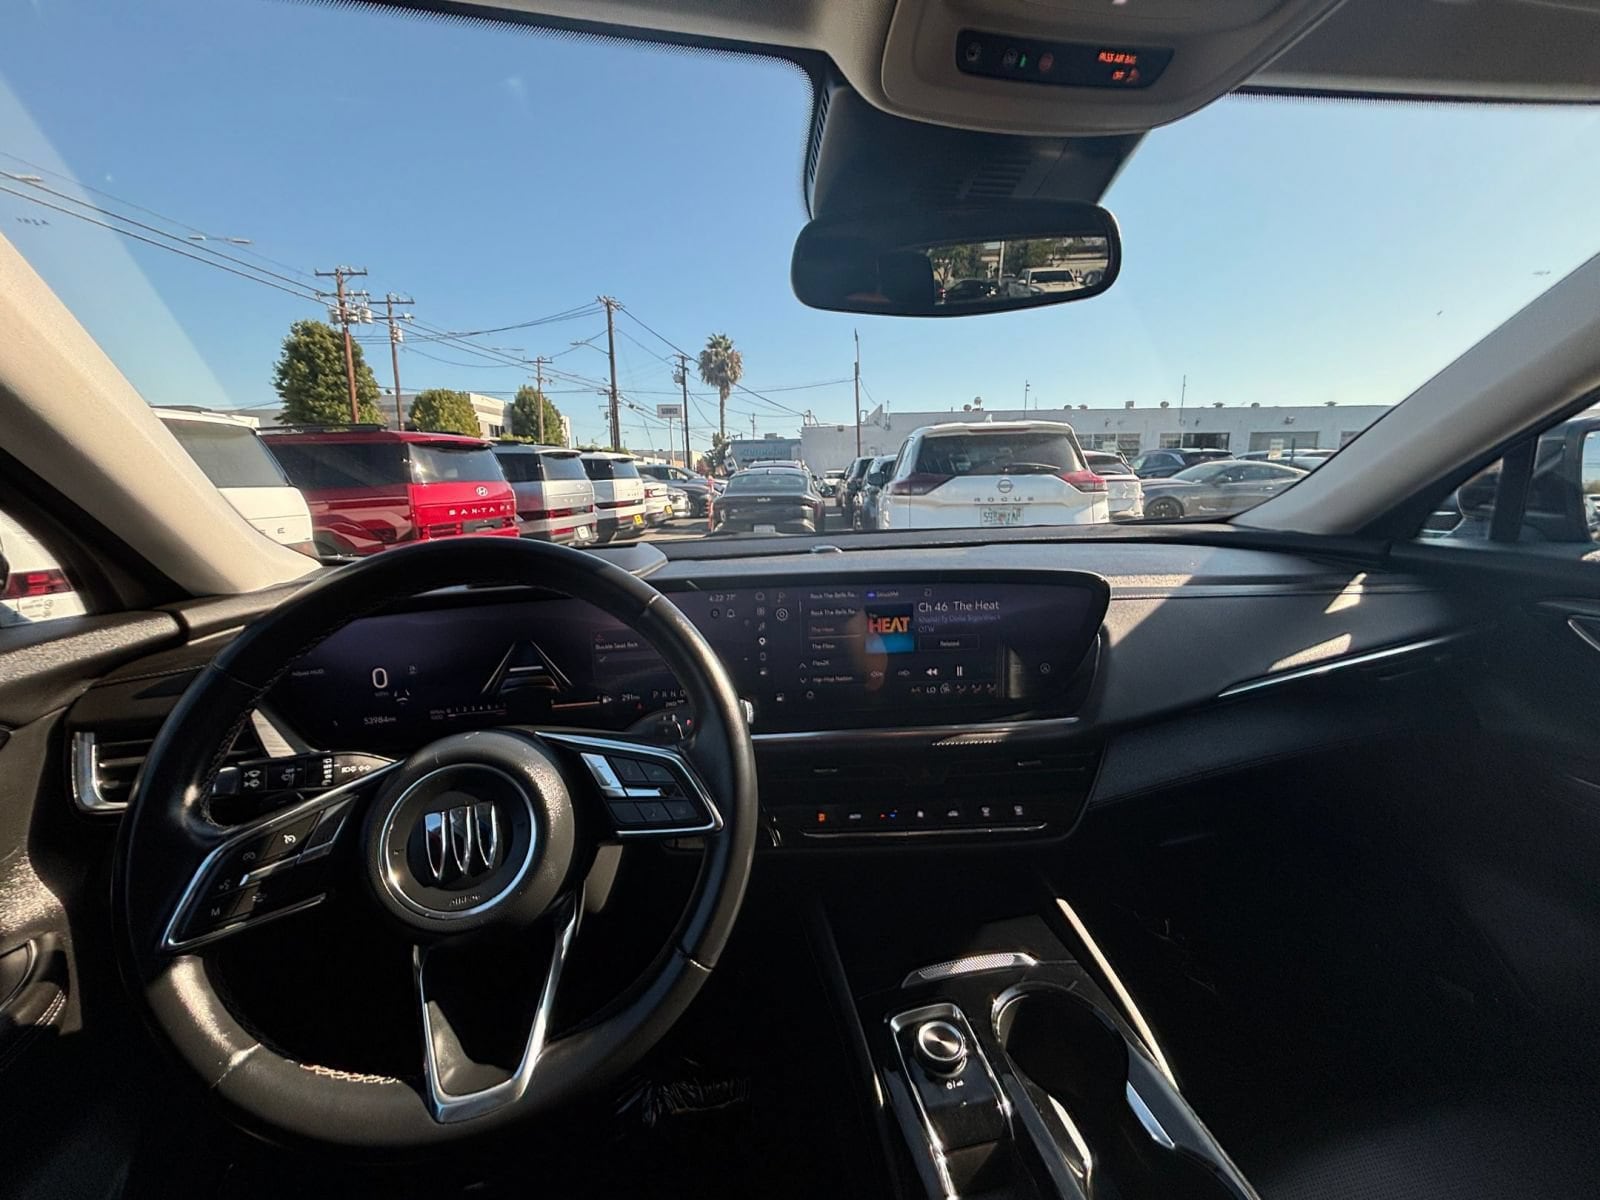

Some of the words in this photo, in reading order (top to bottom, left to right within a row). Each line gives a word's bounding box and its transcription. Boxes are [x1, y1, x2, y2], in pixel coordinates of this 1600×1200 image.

[449, 506, 495, 516] SANTA
[918, 601, 932, 613] Ch
[934, 601, 948, 612] 46
[952, 600, 973, 611] The
[975, 600, 1000, 611] Heat
[867, 616, 911, 635] HEAT
[372, 667, 388, 689] 0
